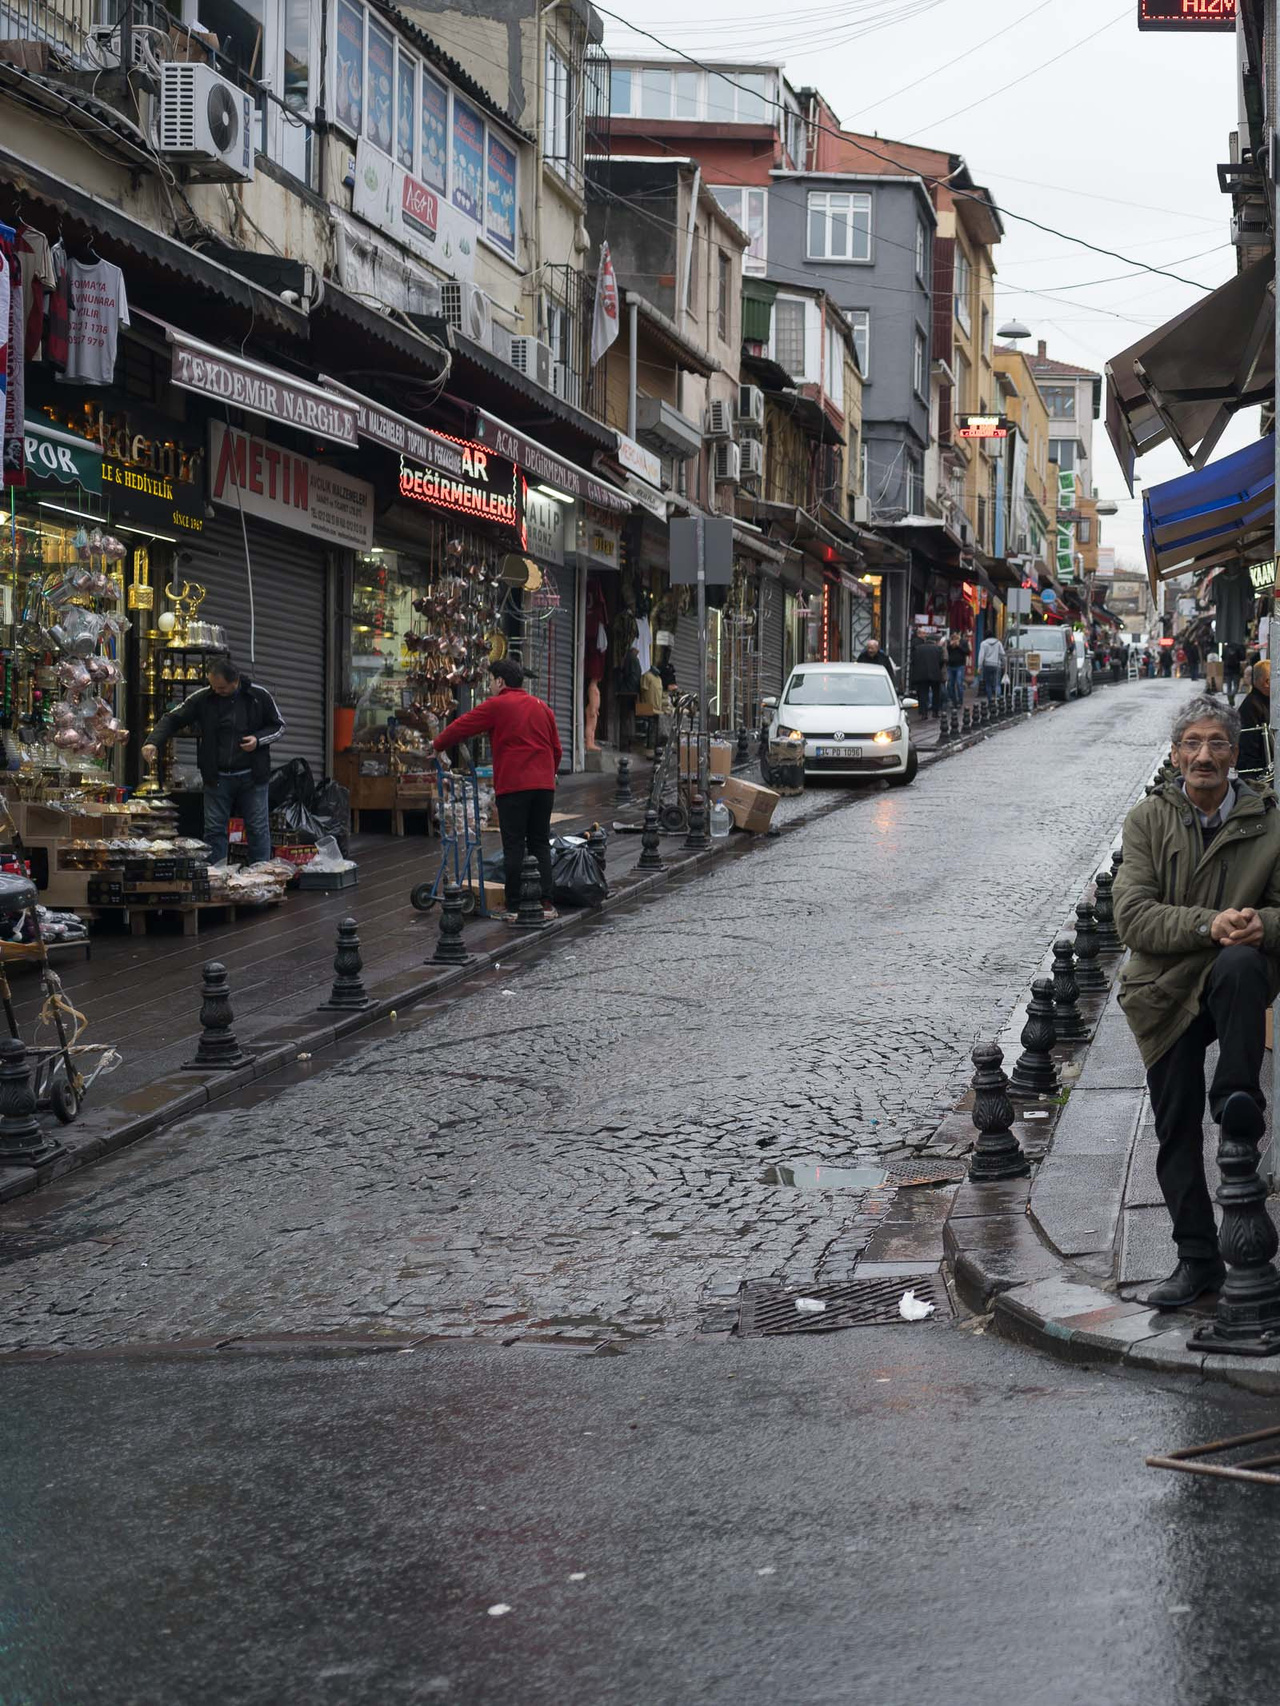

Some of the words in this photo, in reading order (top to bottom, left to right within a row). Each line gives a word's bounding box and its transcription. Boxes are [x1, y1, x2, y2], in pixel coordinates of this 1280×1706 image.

[407, 430, 427, 459] TOPTAN
[495, 430, 519, 461] ACAR
[115, 468, 123, 485] &
[125, 470, 174, 501] HEDİYELİK
[402, 467, 513, 519] DEĞİRMENLERİ
